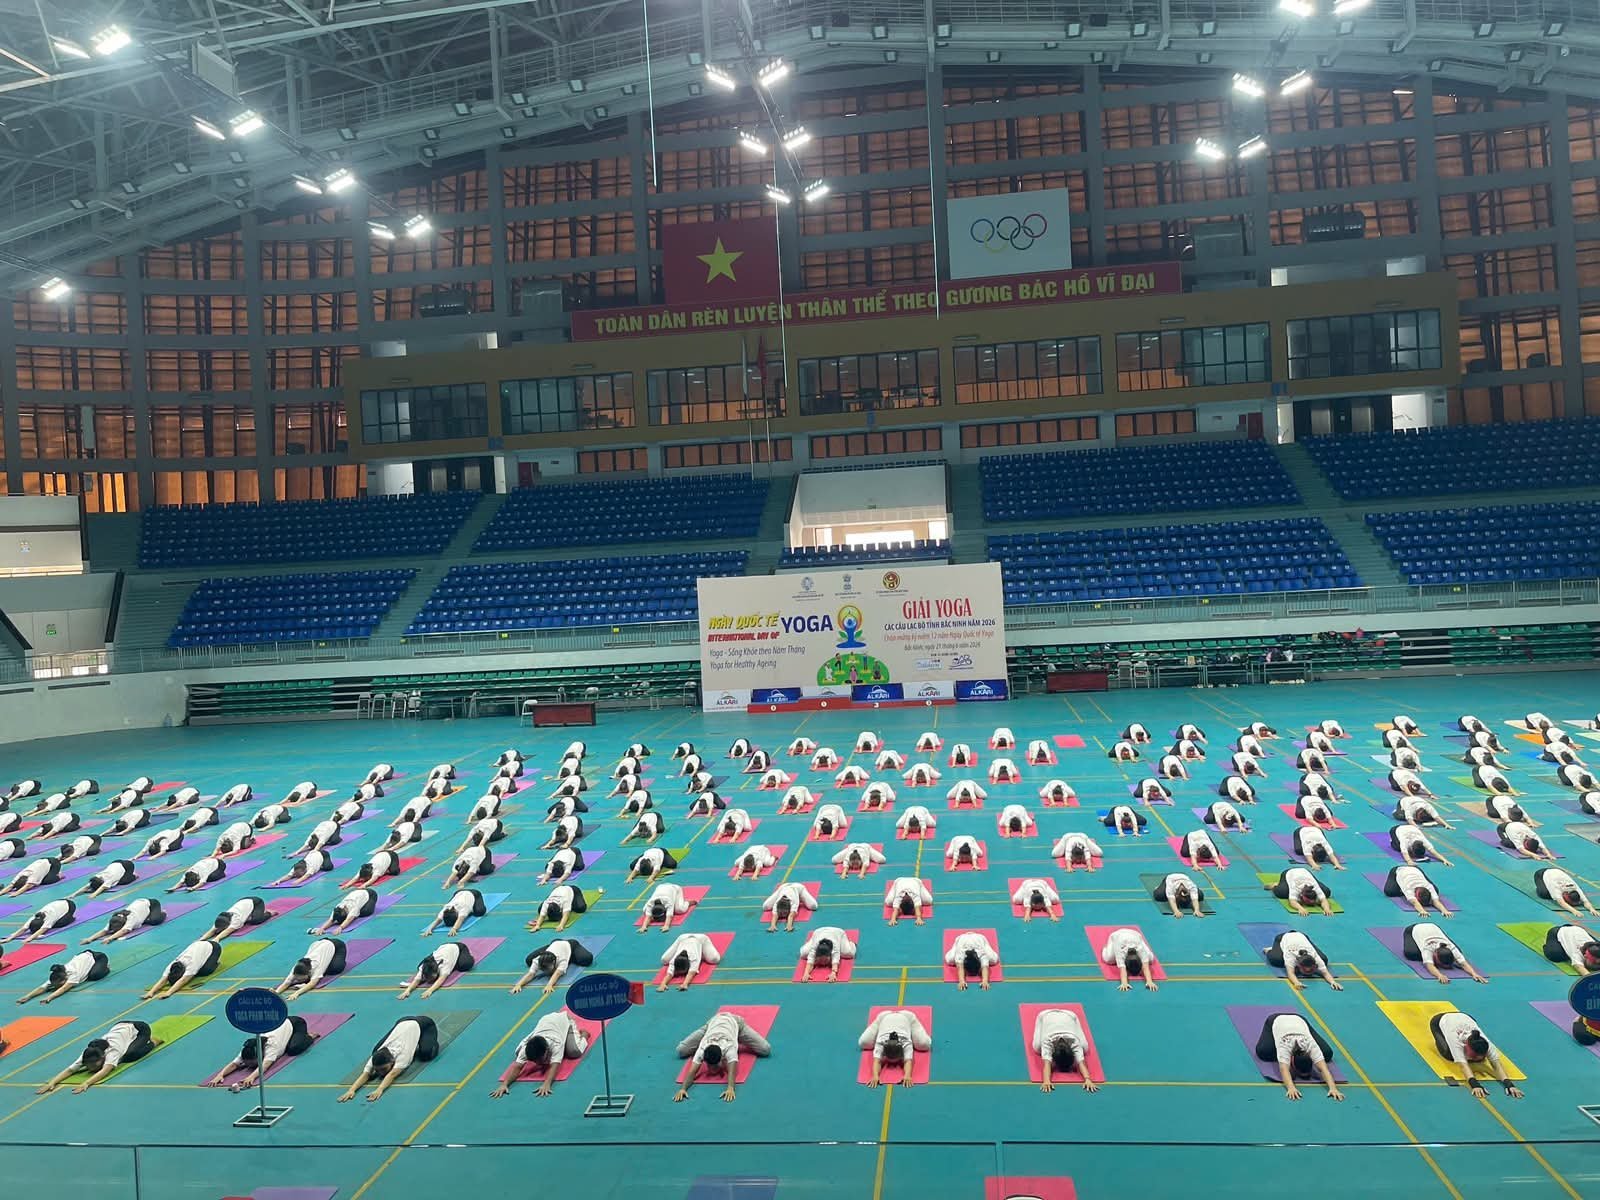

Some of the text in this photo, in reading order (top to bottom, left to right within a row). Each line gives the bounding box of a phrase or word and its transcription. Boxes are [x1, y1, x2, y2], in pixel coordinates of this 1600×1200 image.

[595, 272, 1155, 334] TOÀN DÂN RÈN LUYỆN THÂN THỂ THEO GƯƠNG BÁC HỒ VĨ ĐẠI
[903, 597, 973, 620] GIẢI YOGA
[781, 615, 833, 633] YOGA
[952, 620, 967, 628] NINH
[709, 649, 724, 659] Yoga
[710, 659, 777, 671] Yoga for Healthy Ageing
